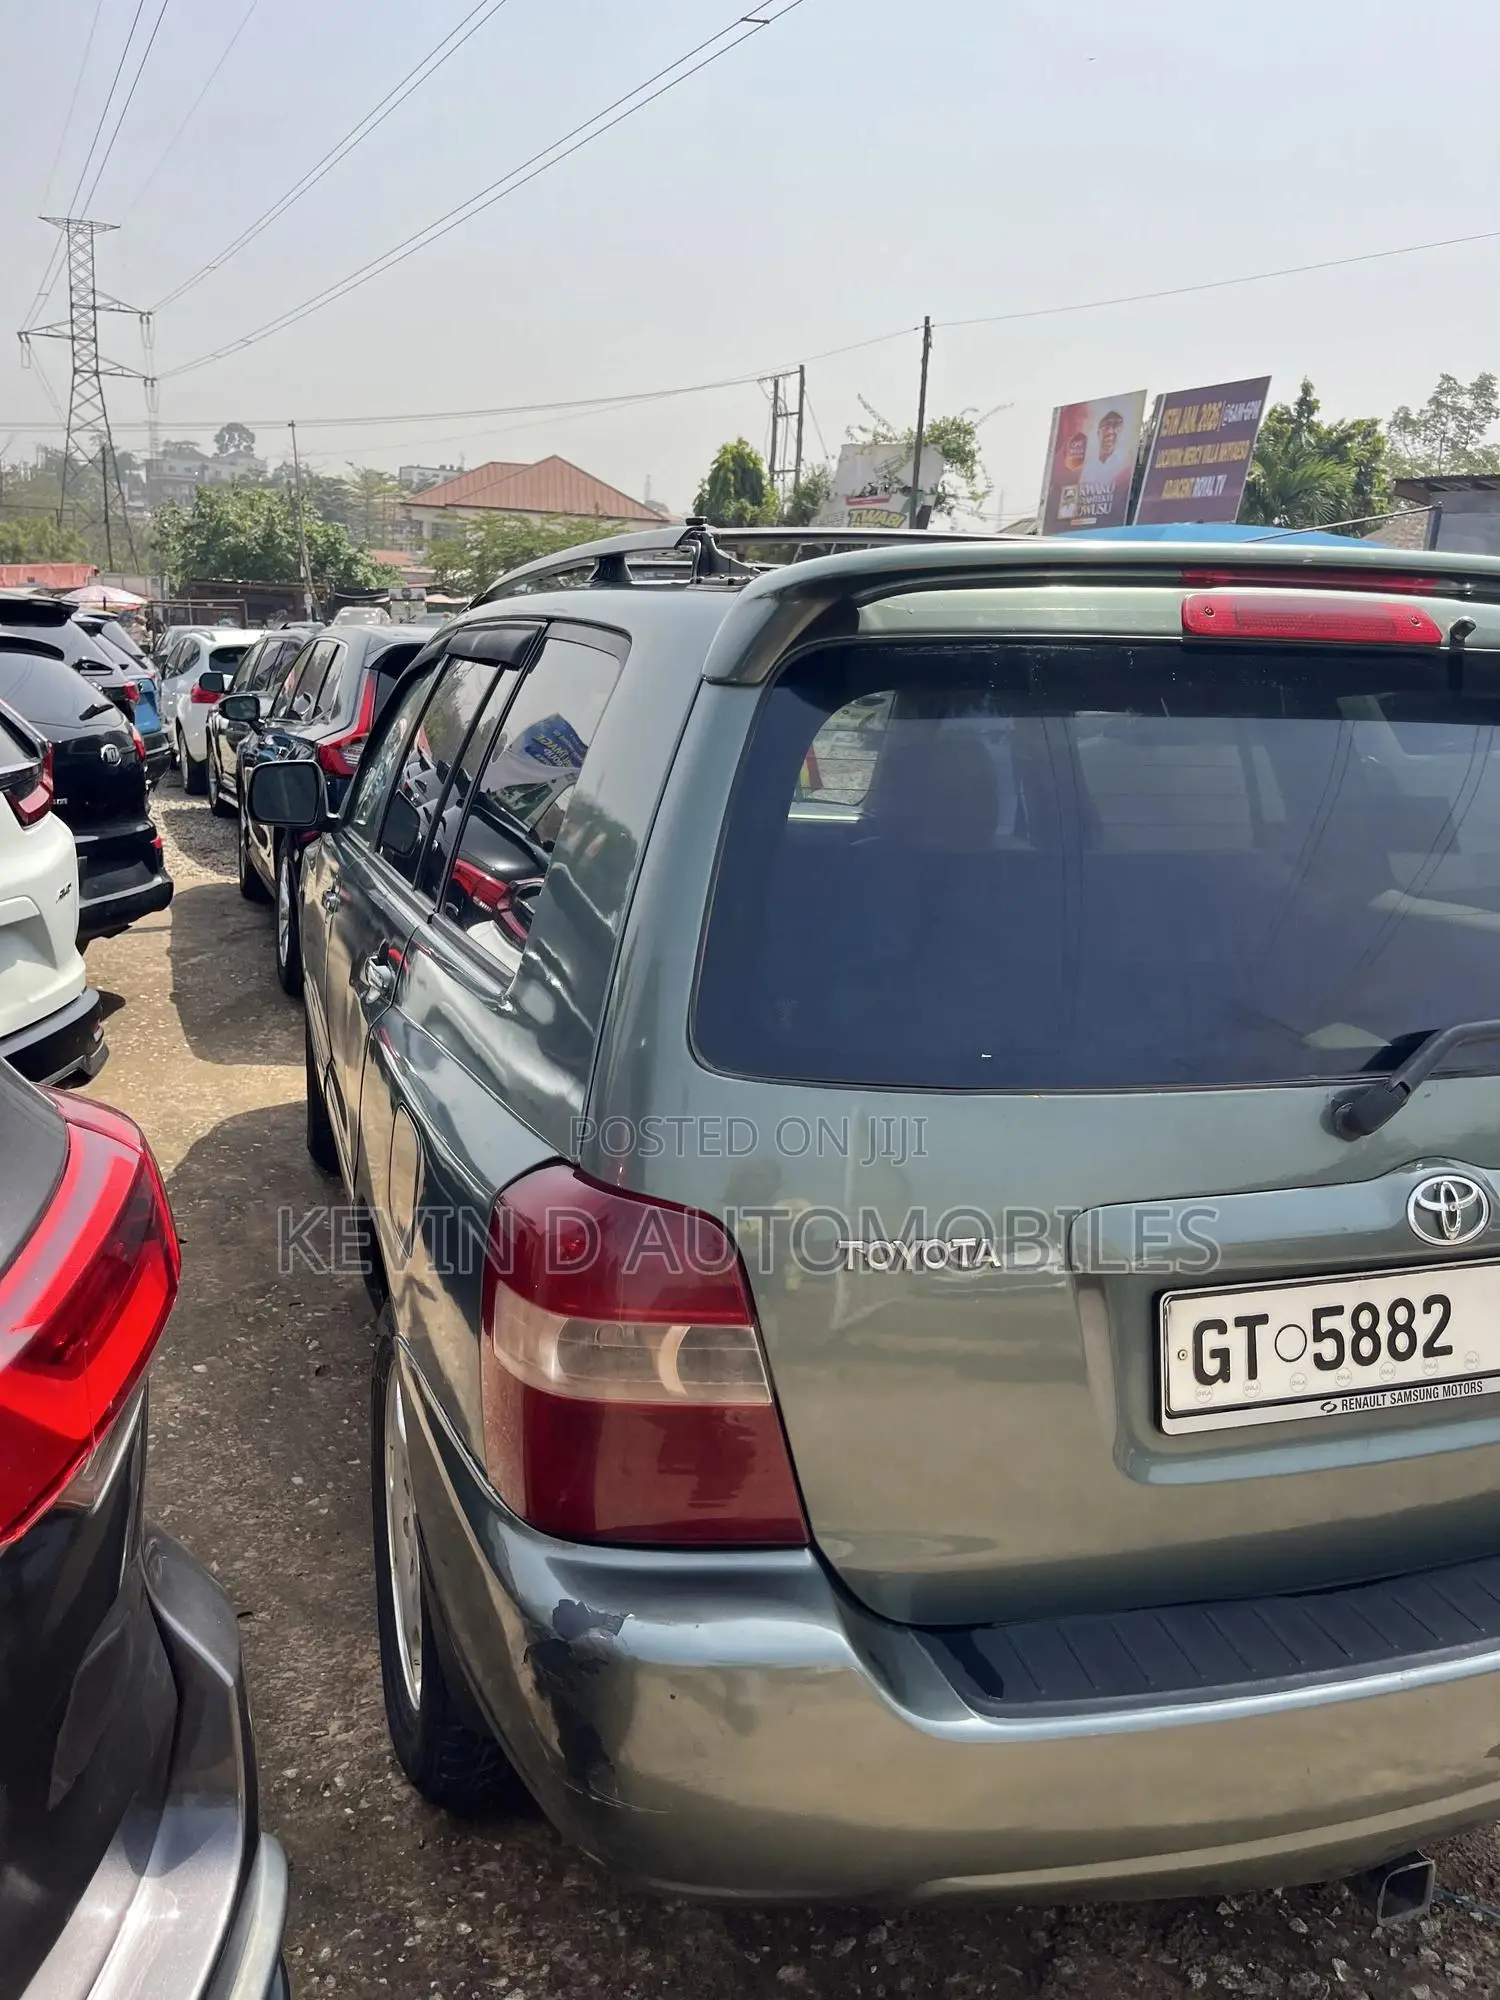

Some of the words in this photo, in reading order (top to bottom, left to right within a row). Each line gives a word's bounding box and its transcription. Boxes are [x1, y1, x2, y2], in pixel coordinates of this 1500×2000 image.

[837, 1237, 1001, 1271] TOYOTA
[1192, 1313, 1269, 1386] GT
[1312, 1294, 1454, 1371] 5882
[1341, 1391, 1386, 1412] RENAULT
[1389, 1386, 1439, 1405] SAMSUNG
[1441, 1380, 1483, 1397] MOTORS
